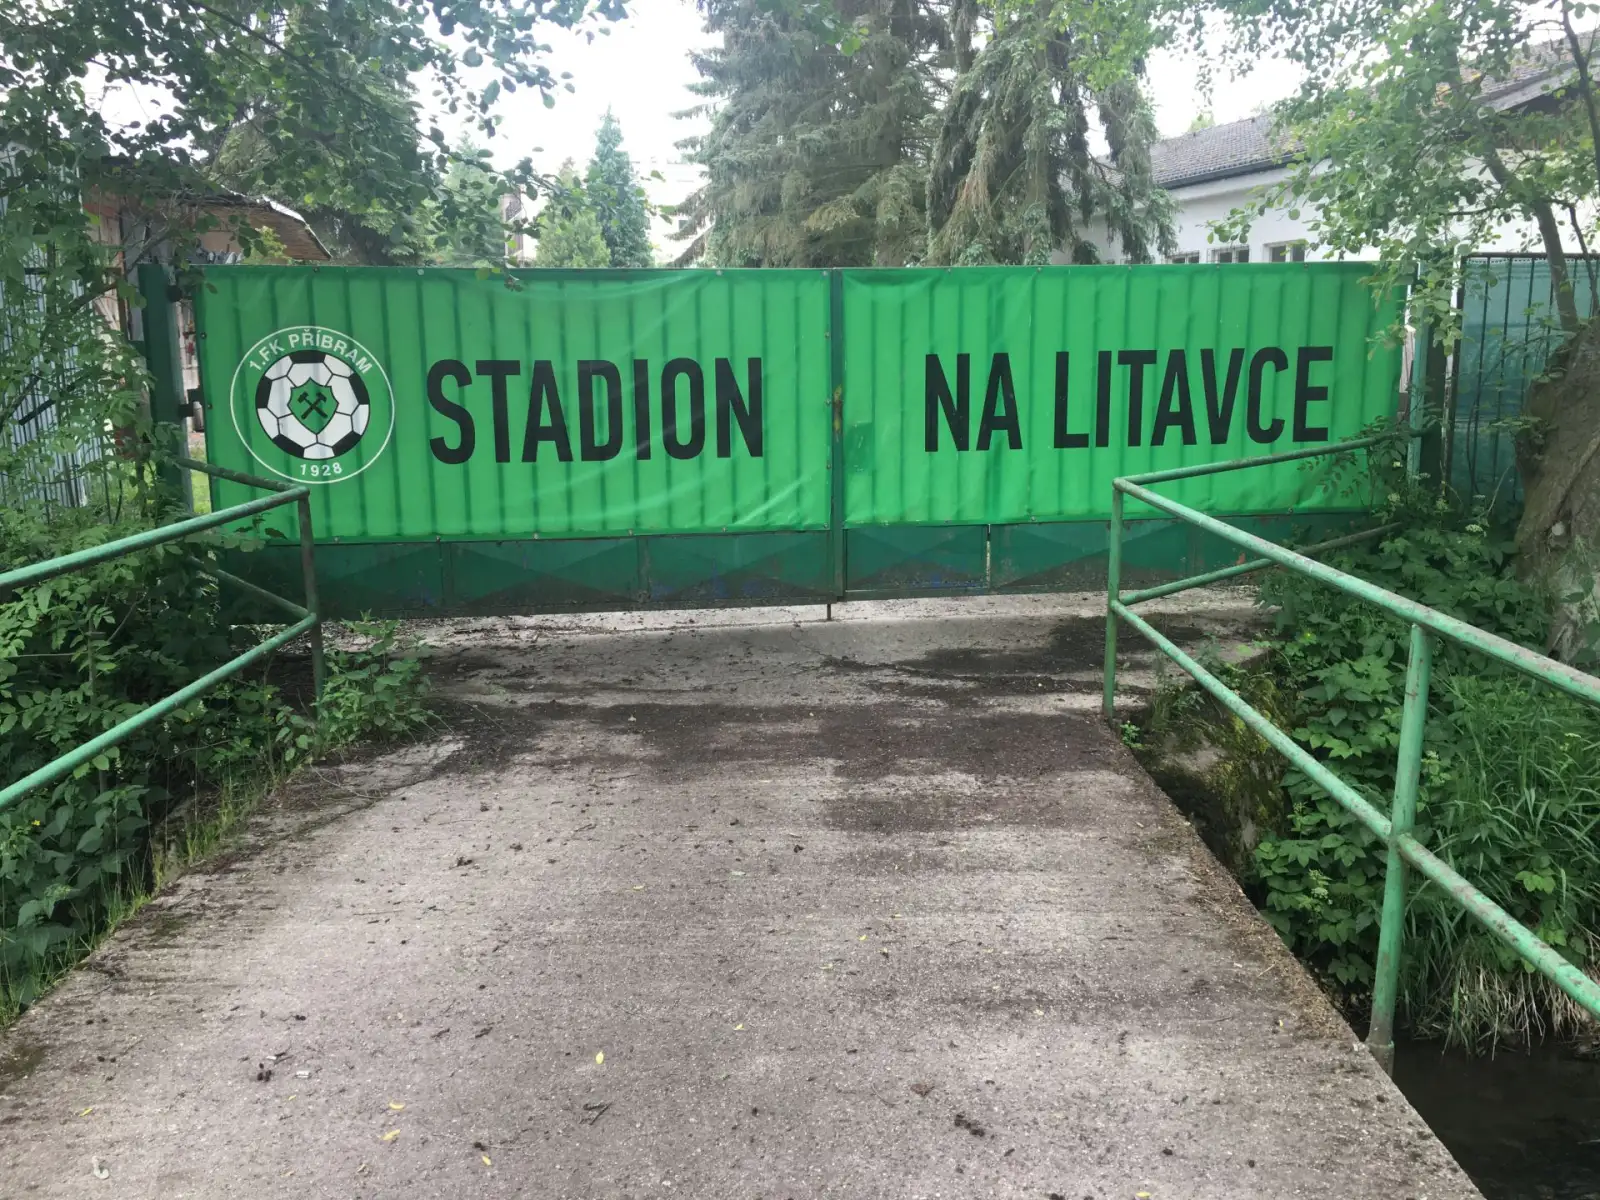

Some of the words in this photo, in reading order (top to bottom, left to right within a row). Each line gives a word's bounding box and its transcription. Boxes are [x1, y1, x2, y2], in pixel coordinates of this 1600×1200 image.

[249, 338, 285, 371] 1.FK
[288, 329, 373, 375] PŘÍBRAM
[427, 357, 763, 465] STADION
[925, 352, 1023, 452] NA
[1053, 346, 1333, 449] LITAVCE
[300, 462, 343, 477] 1928
